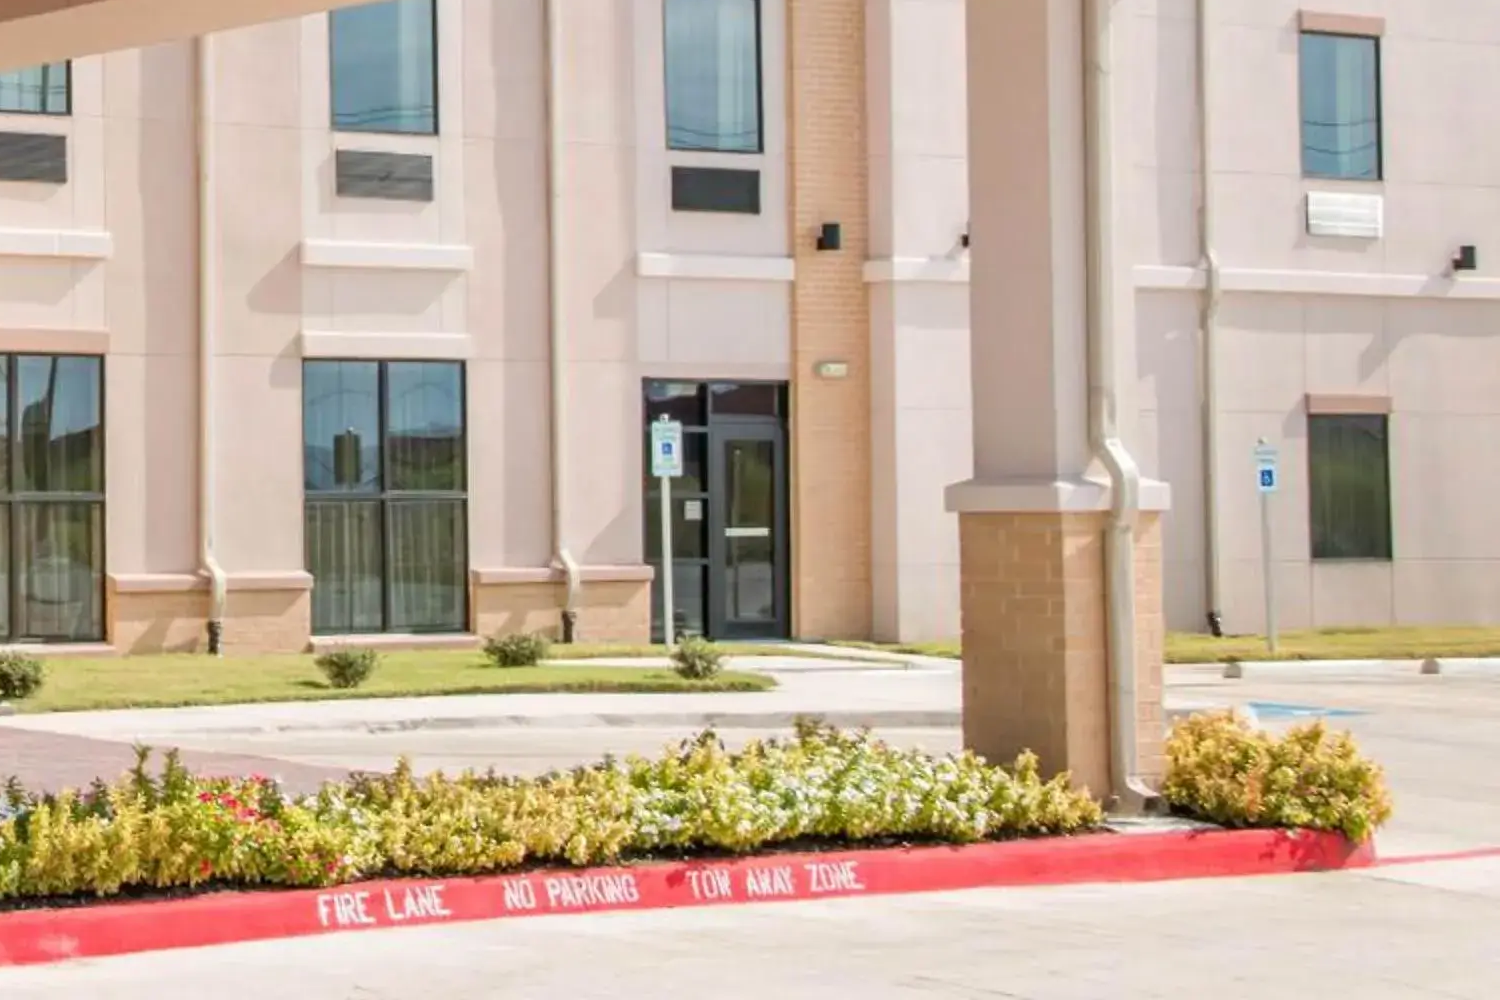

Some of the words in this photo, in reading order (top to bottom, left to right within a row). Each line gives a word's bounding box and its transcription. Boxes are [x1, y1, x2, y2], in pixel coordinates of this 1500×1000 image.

[317, 891, 376, 926] FIRE
[384, 884, 452, 920] LANE
[502, 878, 536, 909] NO
[545, 874, 639, 907] PARKING
[686, 869, 732, 899] TOW
[746, 865, 794, 896] AWAY
[804, 860, 866, 892] ZONE
